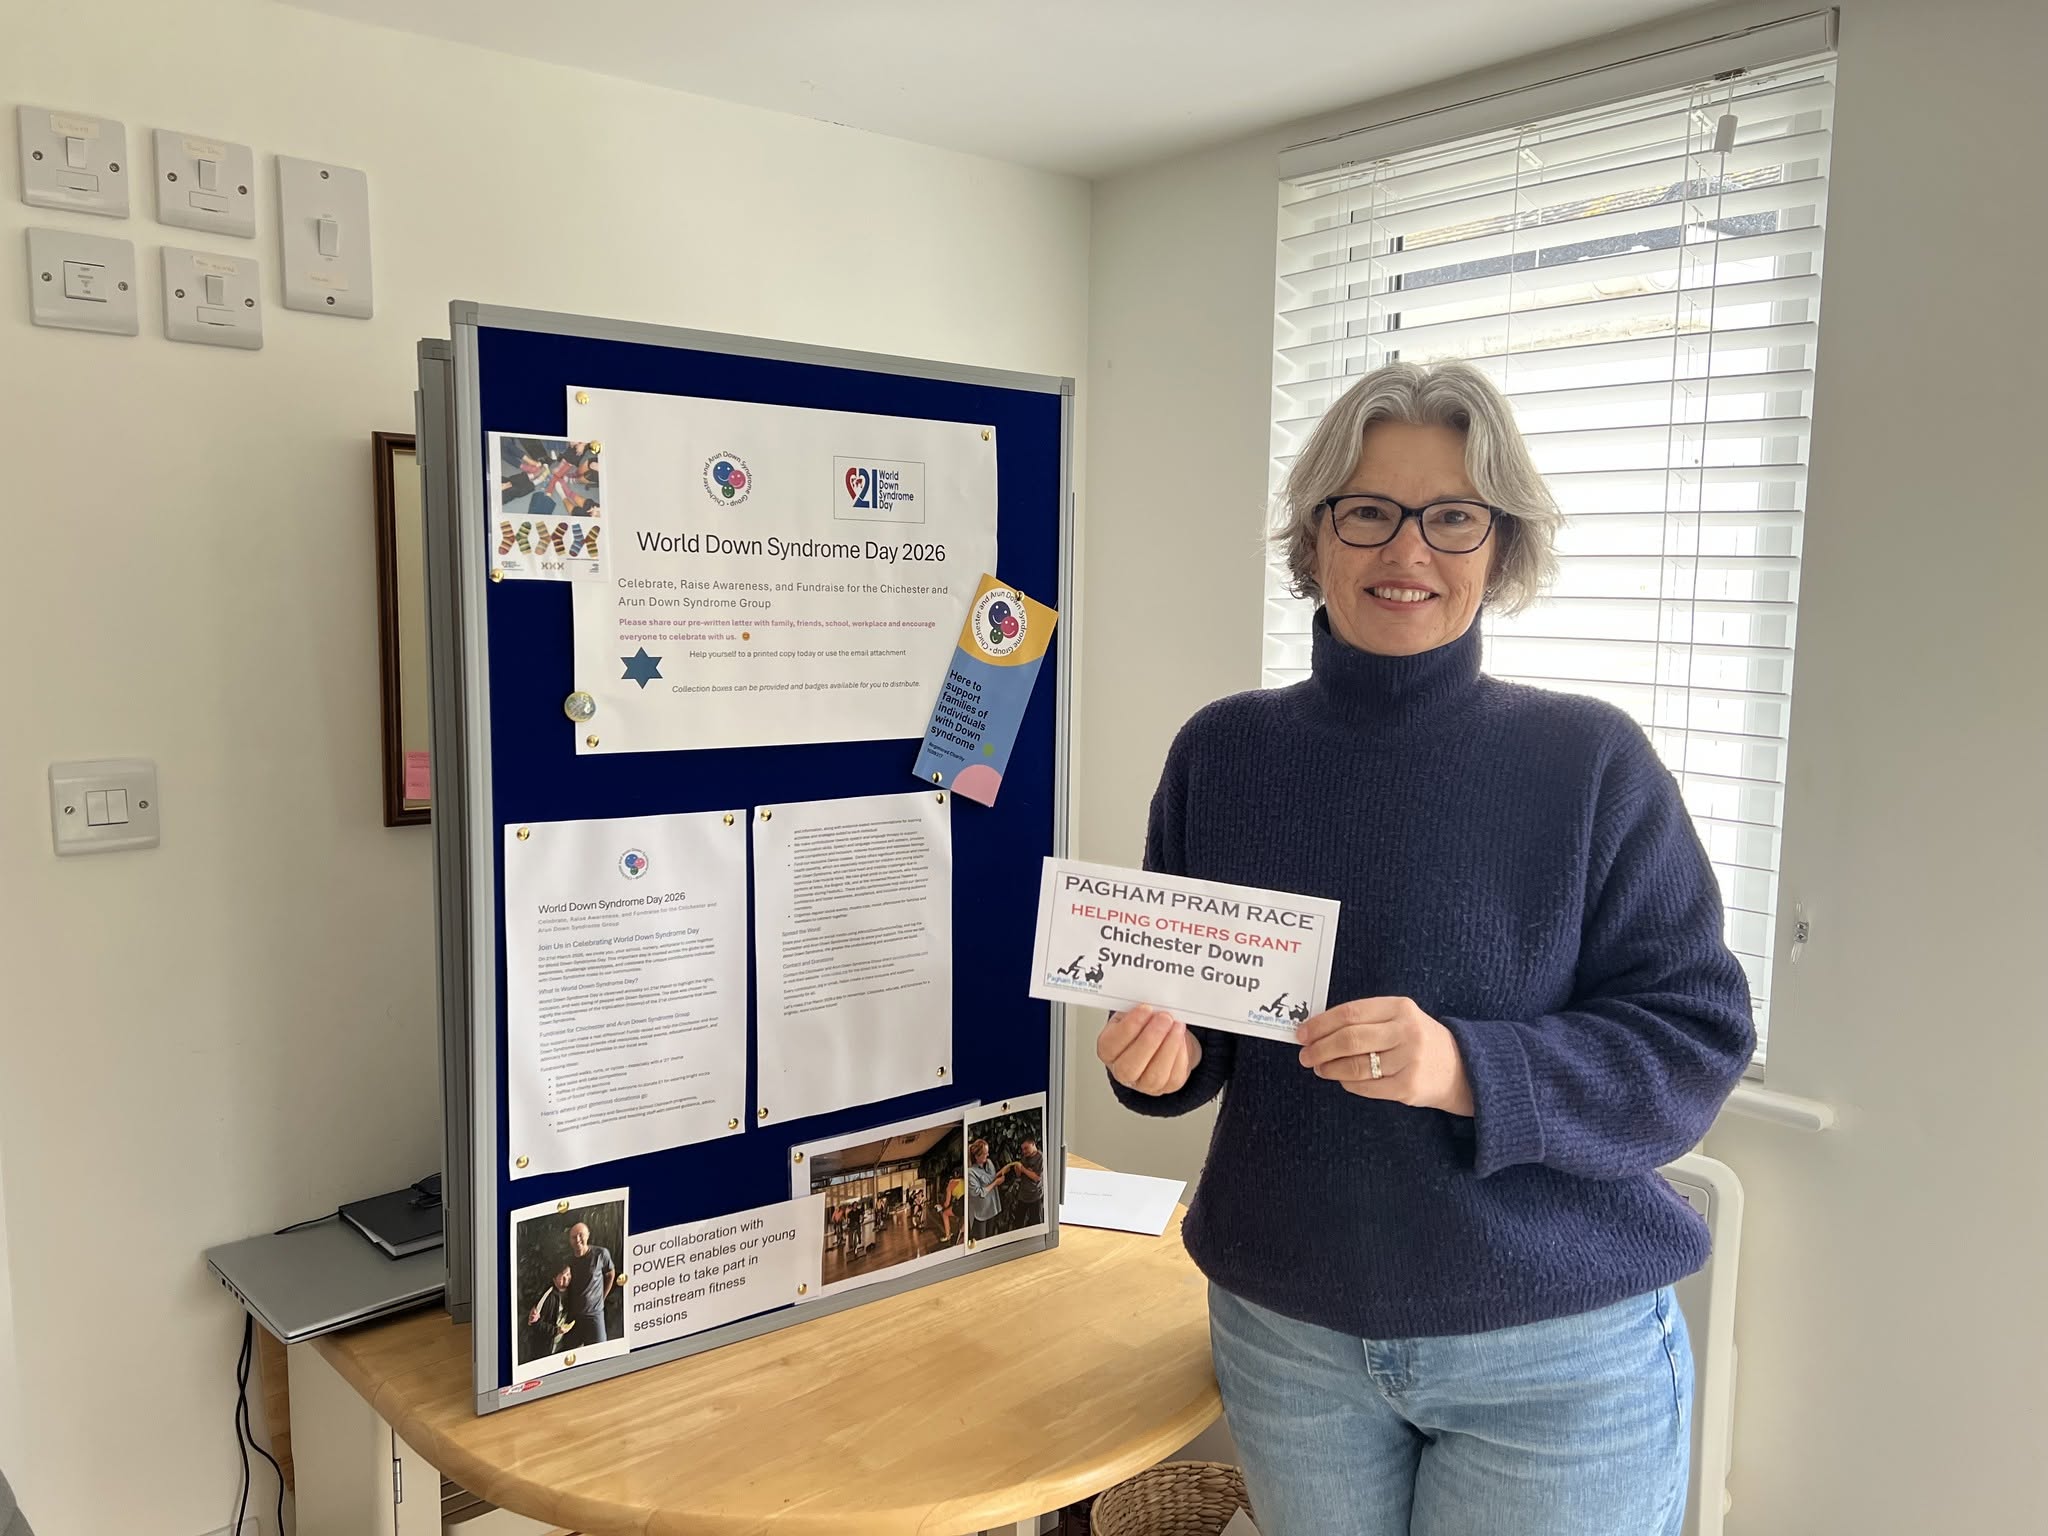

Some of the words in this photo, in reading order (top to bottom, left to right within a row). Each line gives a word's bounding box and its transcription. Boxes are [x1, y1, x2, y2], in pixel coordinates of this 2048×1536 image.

[708, 452, 722, 463] Arun
[723, 451, 741, 462] Down
[741, 461, 752, 494] Syndrome
[879, 470, 899, 481] World
[879, 481, 899, 491] Down
[703, 477, 725, 506] Chichester
[730, 494, 748, 506] Group
[879, 490, 914, 503] Syndrome
[879, 499, 893, 512] Day
[637, 531, 700, 554] World
[707, 535, 762, 556] Down
[768, 537, 860, 561] Syndrome
[866, 541, 898, 564] Day
[903, 544, 946, 562] 2026
[618, 578, 677, 590] Celebrate,
[680, 580, 710, 590] Raise
[713, 580, 772, 592] Awareness,
[776, 582, 793, 592] and
[797, 582, 844, 592] Fundraise
[847, 584, 859, 592] for
[862, 584, 878, 592] the
[880, 584, 928, 594] Chichester
[932, 585, 948, 594] and
[618, 597, 645, 606] Arun
[649, 597, 680, 607] Down
[683, 597, 736, 609] Syndrome
[740, 598, 771, 610] Group
[979, 595, 990, 610] and
[1006, 592, 1022, 610] Down
[619, 618, 647, 626] Please
[649, 618, 671, 626] share
[772, 620, 795, 628] family,
[797, 620, 824, 628] friends,
[976, 611, 988, 649] Chichester
[1013, 610, 1026, 648] Syndrome
[620, 634, 657, 642] everyone
[690, 650, 708, 658] Help
[708, 650, 736, 658] yourself
[753, 650, 778, 658] printed
[797, 650, 816, 658] today
[672, 684, 710, 692] Collection
[712, 684, 732, 692] boxes
[759, 683, 789, 691] provided
[950, 670, 971, 686] Here
[972, 682, 982, 692] to
[946, 682, 980, 704] support
[938, 702, 986, 730] individuals
[942, 692, 976, 714] families
[978, 710, 988, 719] of
[931, 726, 974, 750] syndrome
[936, 714, 954, 729] with
[955, 723, 981, 742] Down
[538, 904, 566, 914] World
[569, 902, 597, 912] Down
[598, 898, 644, 910] Syndrome
[646, 896, 663, 904] Day
[664, 892, 686, 902] 2026
[1066, 876, 1164, 905] PAGHAM
[1172, 894, 1240, 918] PRAM
[1247, 906, 1314, 930] RACE
[1072, 903, 1150, 928] HELPING
[1156, 918, 1230, 941] OTHERS
[1235, 931, 1301, 953] GRANT
[538, 944, 552, 952] Join
[572, 938, 612, 948] Celebrating
[613, 935, 634, 943] World
[656, 930, 686, 939] Syndrome
[1100, 925, 1202, 956] Chichester
[1208, 944, 1264, 968] Down
[1047, 973, 1071, 984] Pagham
[1098, 947, 1194, 977] Syndrome
[1200, 966, 1260, 992] Group
[1248, 1010, 1274, 1022] Pagham
[1275, 1016, 1291, 1026] Pram
[633, 1242, 656, 1257] Our
[660, 1225, 738, 1251] collaboration
[740, 1217, 764, 1234] with
[633, 1254, 686, 1276] POWER
[690, 1243, 736, 1264] enables
[739, 1238, 758, 1251] our
[762, 1228, 796, 1248] young
[633, 1276, 676, 1296] people
[679, 1272, 691, 1285] to
[694, 1264, 719, 1280] take
[722, 1259, 746, 1276] part
[748, 1254, 758, 1266] in
[633, 1287, 706, 1314] mainstream
[709, 1275, 746, 1295] fitness
[634, 1309, 688, 1332] sessions
